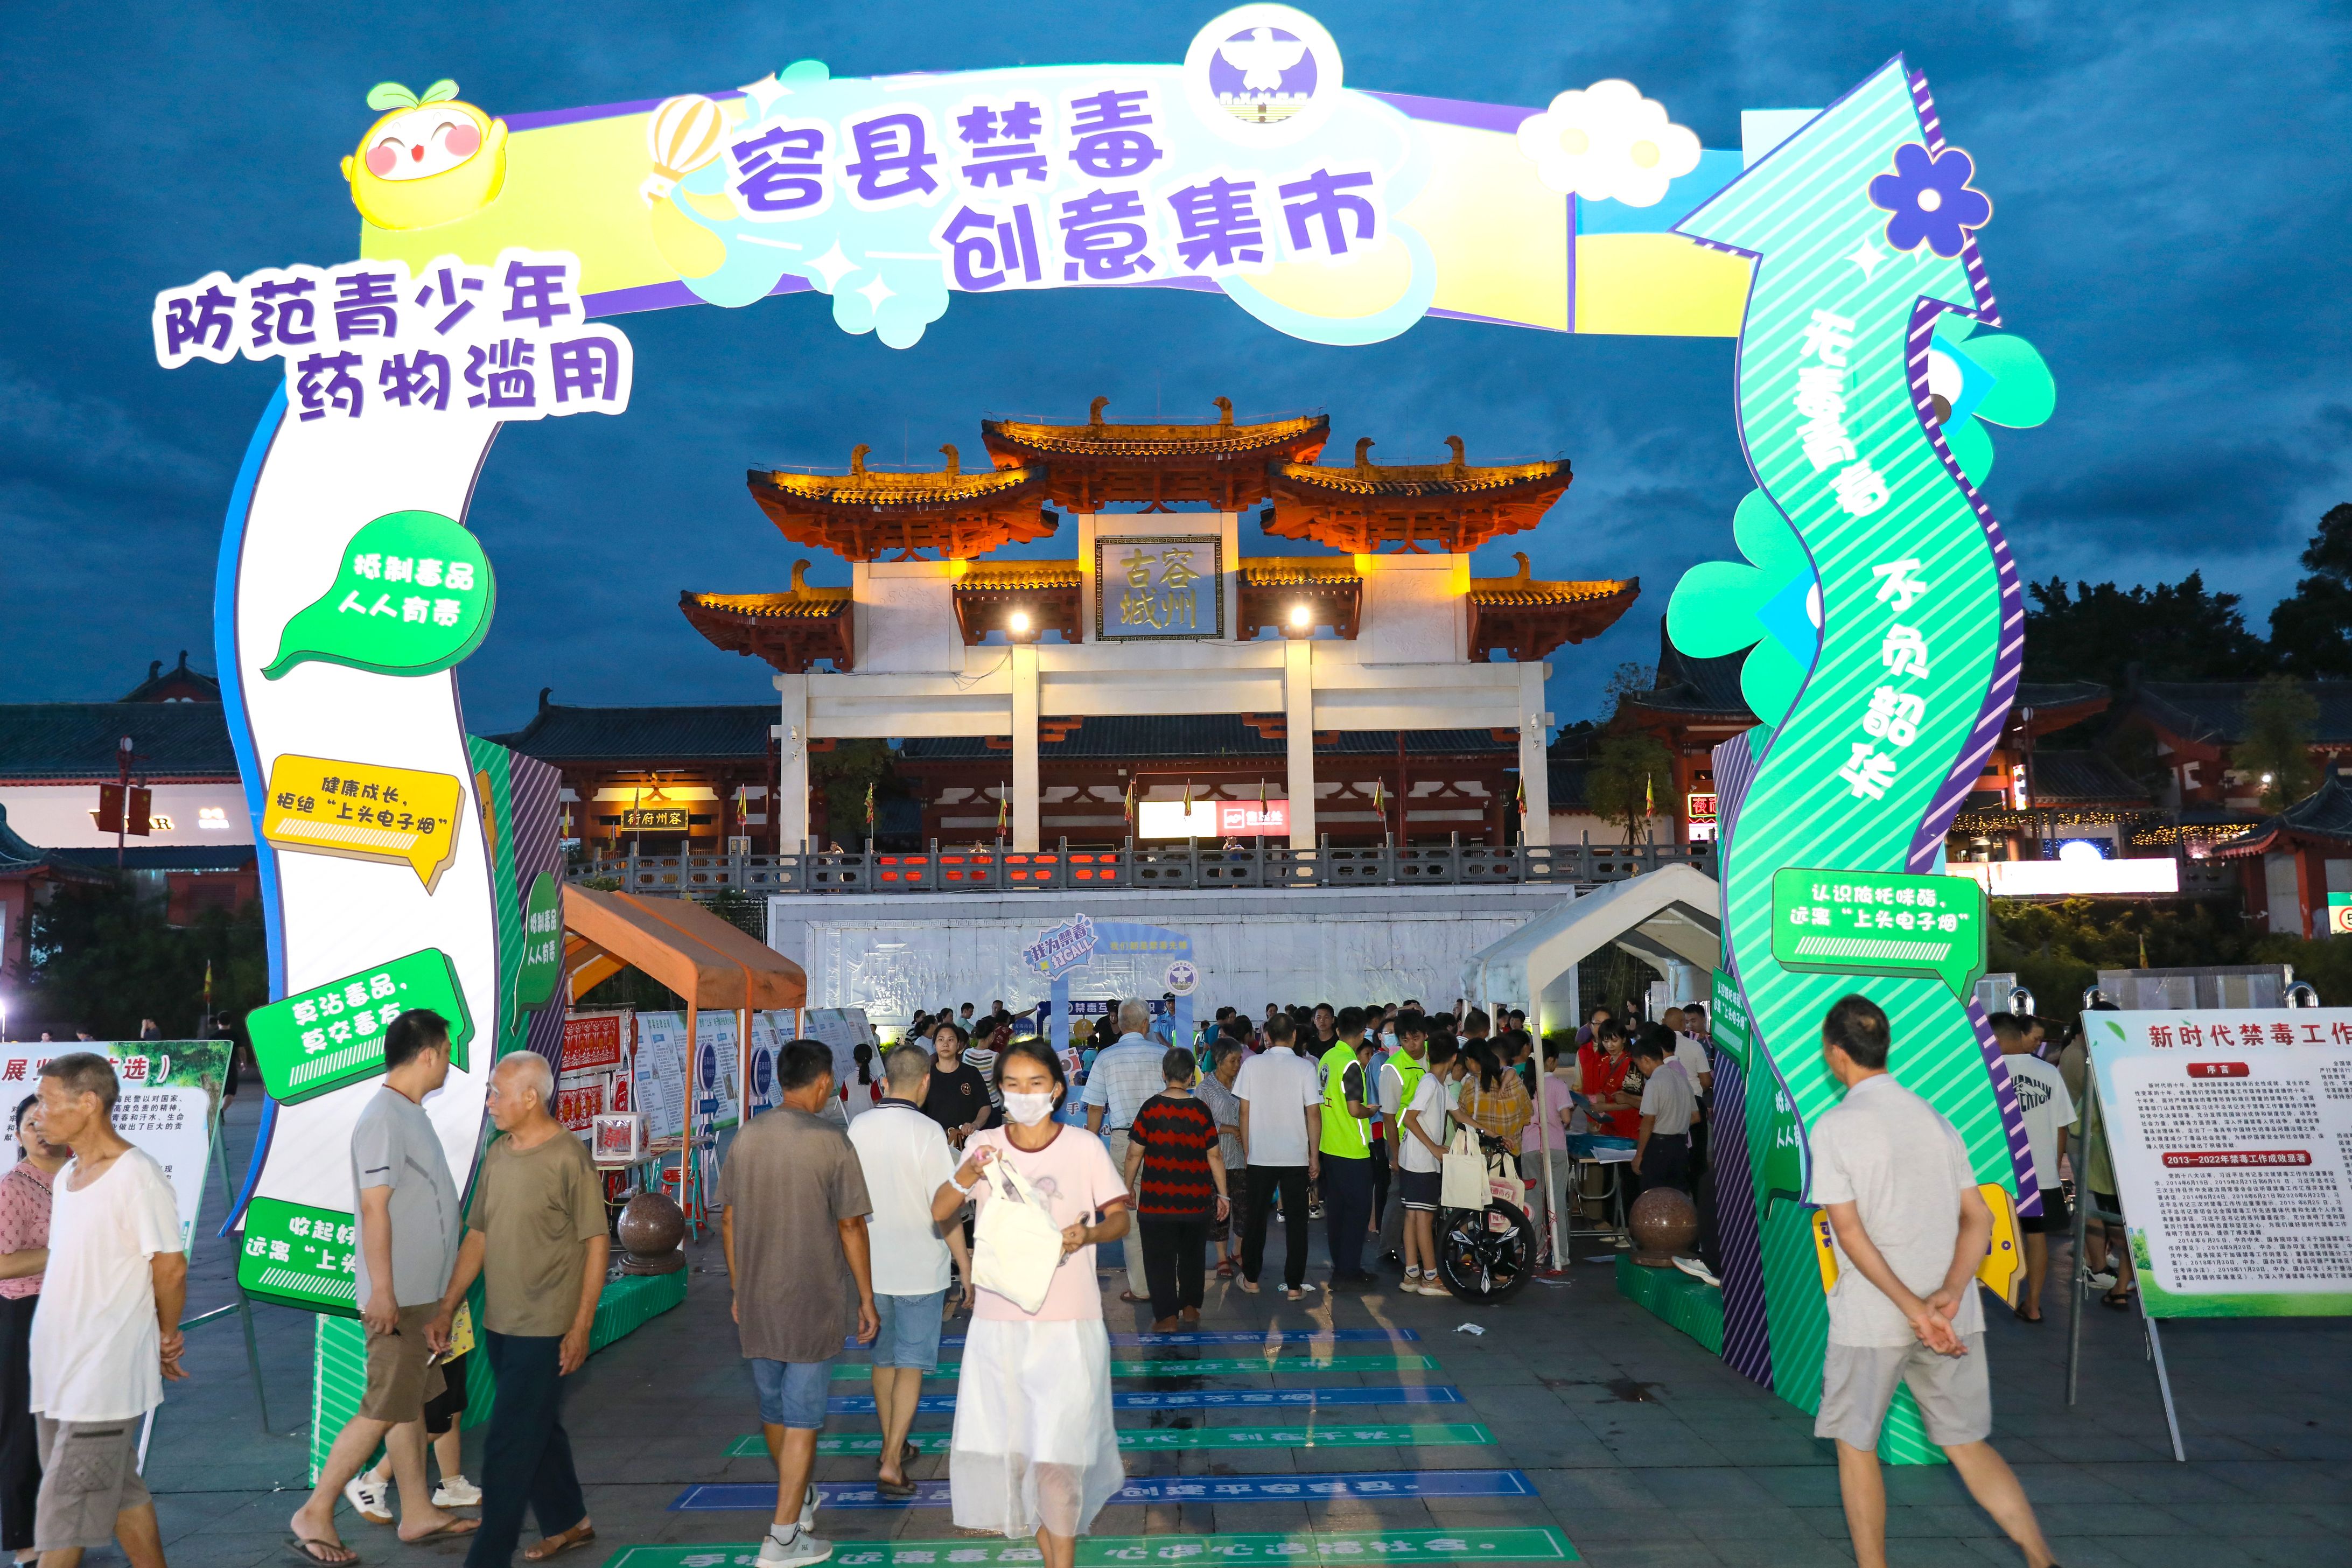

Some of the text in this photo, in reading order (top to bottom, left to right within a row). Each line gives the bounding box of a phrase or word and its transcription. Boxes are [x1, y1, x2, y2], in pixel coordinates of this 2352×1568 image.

[731, 89, 1164, 212] 容县禁毒
[941, 168, 1376, 292] 创意集市
[165, 261, 571, 355] 防范青少年
[296, 337, 619, 422] 药物滥用
[354, 554, 474, 591] 抵制毒品
[1120, 548, 1161, 629] 古城
[1159, 548, 1200, 628] 容州
[338, 590, 461, 627] 人人有责
[1838, 558, 1930, 801] 不负韶华
[530, 908, 557, 934] 抵制毒品
[528, 940, 556, 967] 人人有责
[1031, 922, 1088, 962] 我为禁毒
[1051, 939, 1093, 970] 打CALL
[2147, 1022, 2352, 1048] 新时代禁毒工作
[2207, 1065, 2230, 1075] 序言
